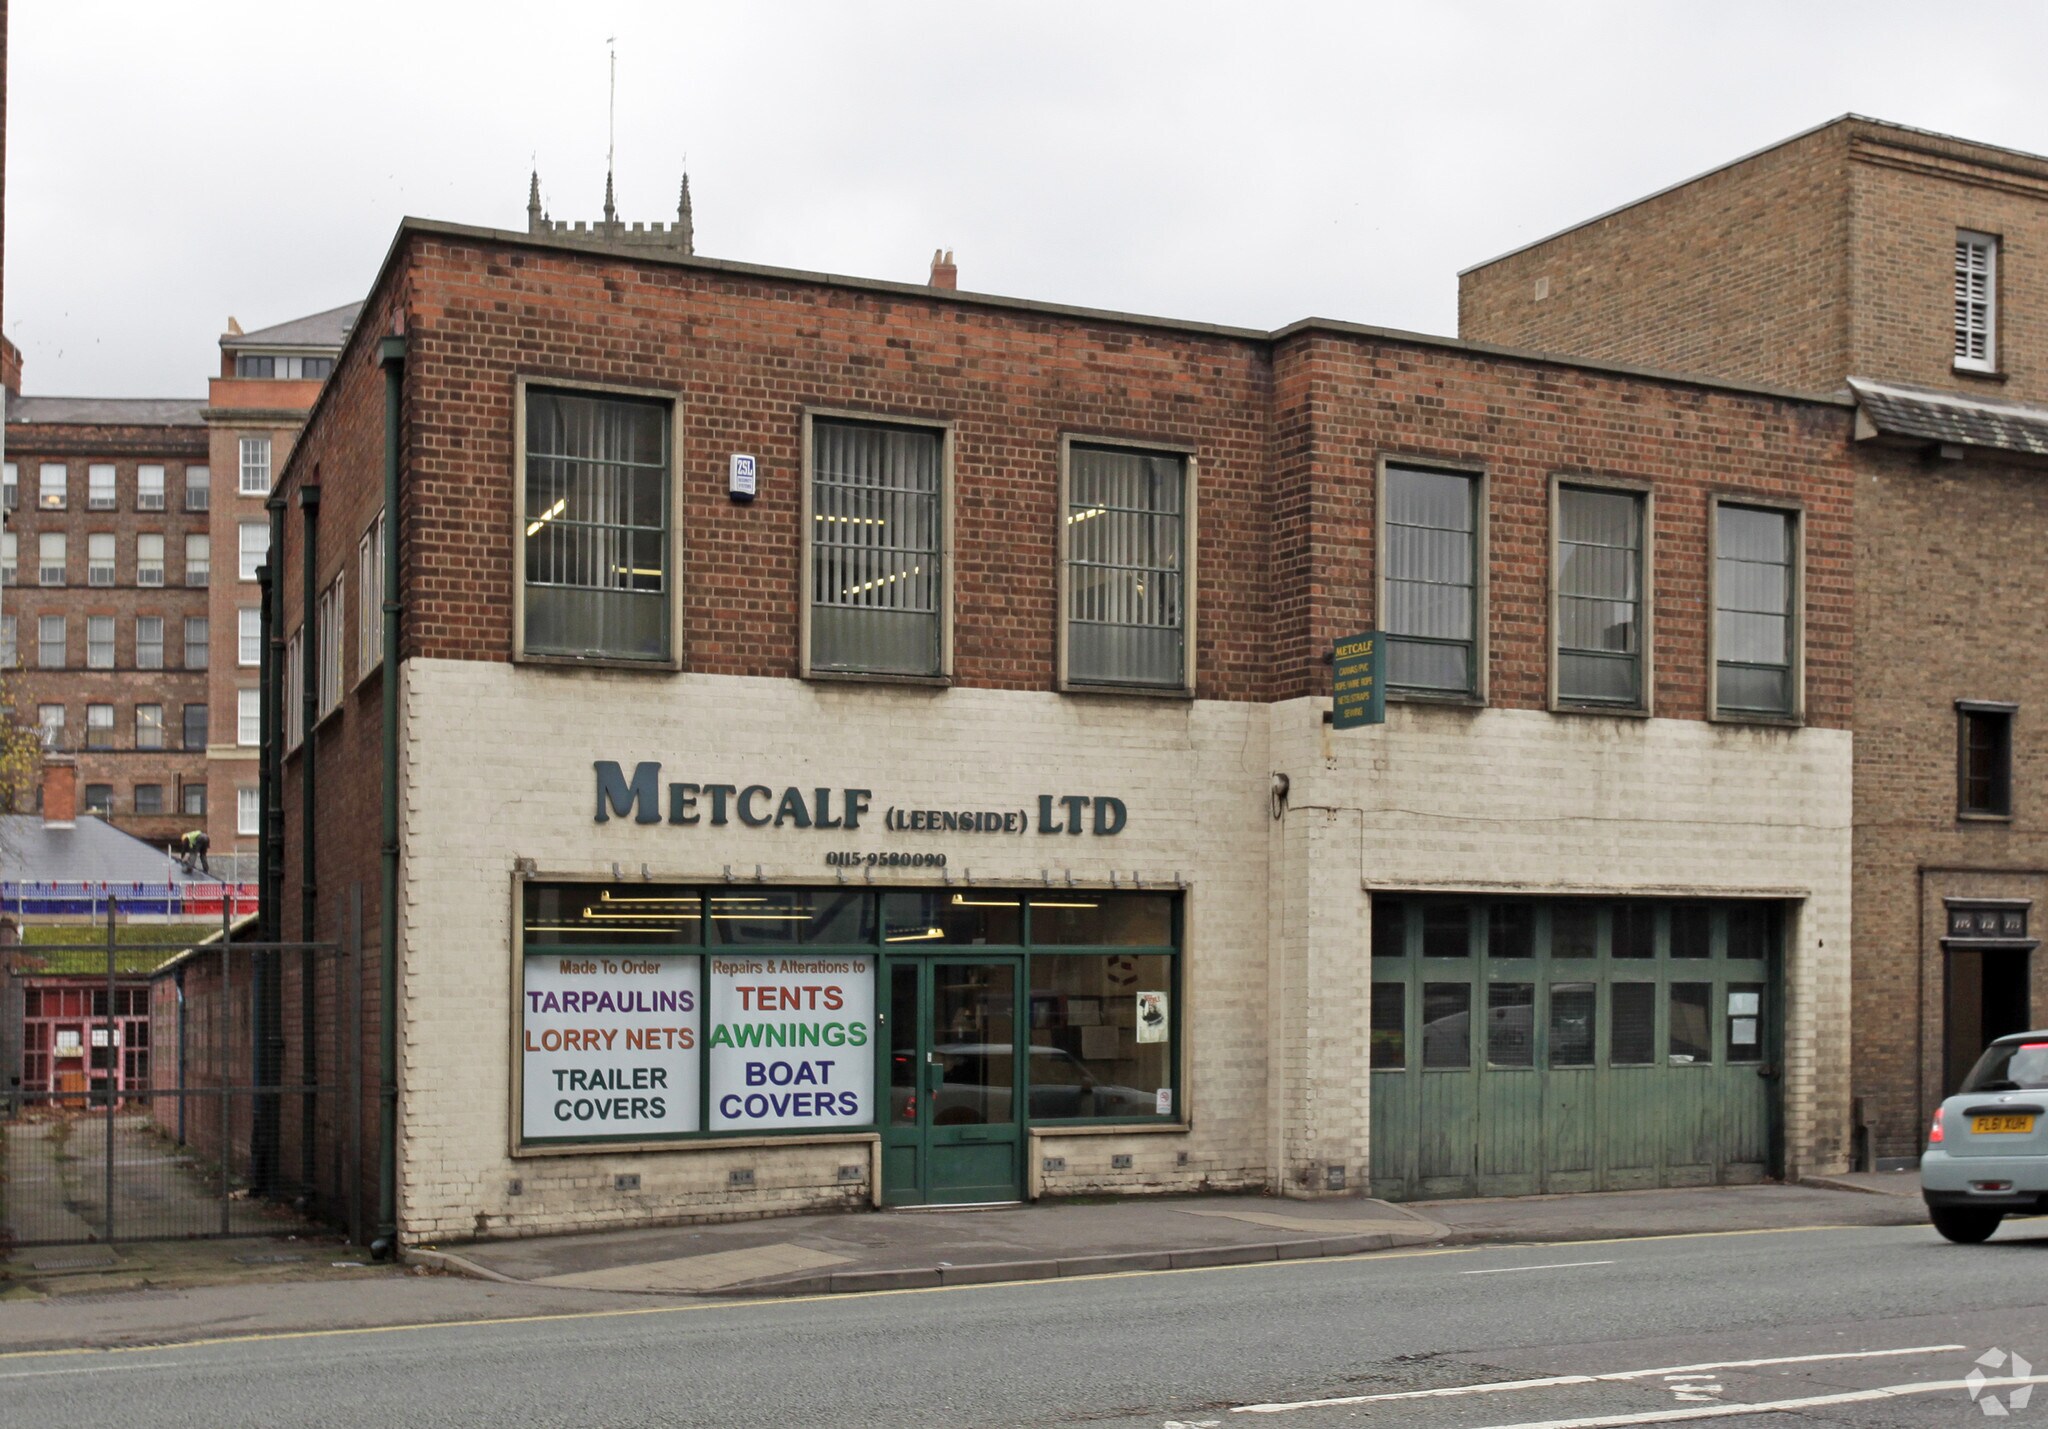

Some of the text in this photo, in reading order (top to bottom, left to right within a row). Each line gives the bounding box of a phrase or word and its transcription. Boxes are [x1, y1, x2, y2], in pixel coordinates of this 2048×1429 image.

[1335, 641, 1373, 656] METCALF
[593, 760, 1127, 836] METCALF (LEENSIDE) LTD
[826, 850, 947, 868] 0115-9580090
[559, 959, 661, 975] Made To Order
[712, 959, 866, 976] Repairs & Alterations to
[526, 990, 695, 1014] TARPAULINS
[735, 985, 844, 1012] TENTS
[525, 1027, 695, 1051] LORRY NETS
[710, 1021, 868, 1048] AWNINGS
[552, 1067, 668, 1091] TRAILER
[745, 1060, 835, 1087] BOAT
[554, 1096, 667, 1121] COVERS
[719, 1091, 859, 1120] COVERS
